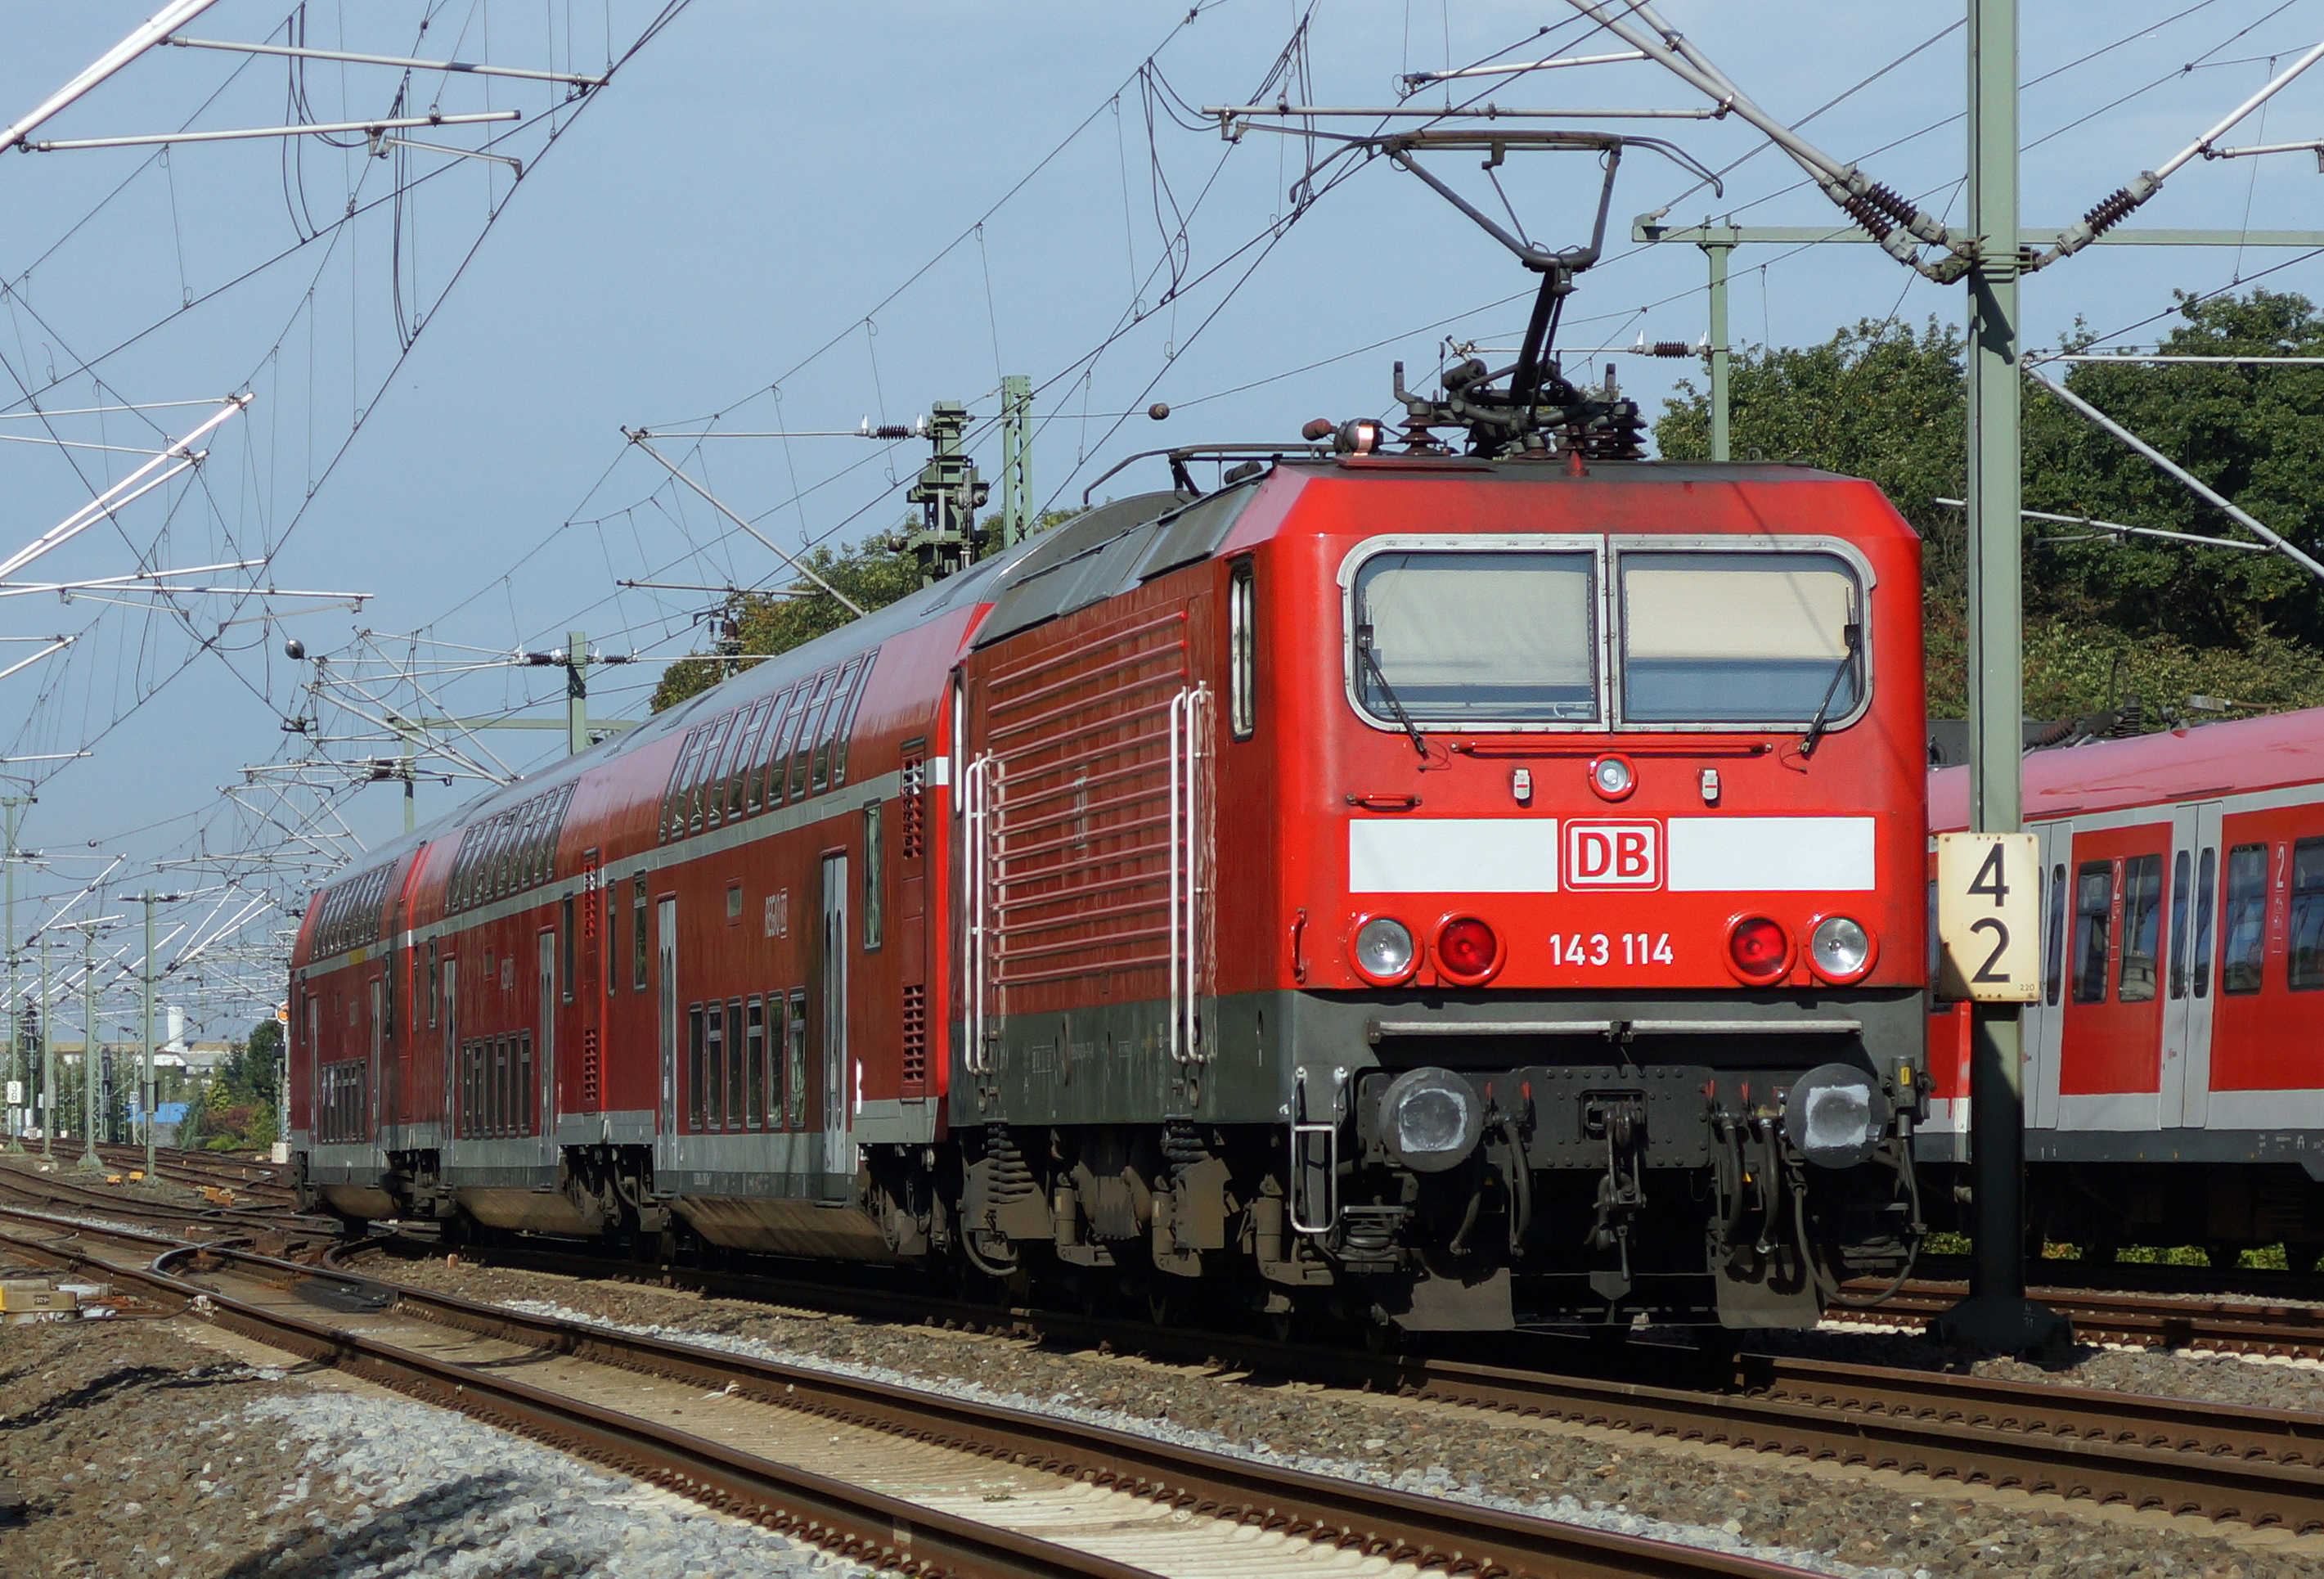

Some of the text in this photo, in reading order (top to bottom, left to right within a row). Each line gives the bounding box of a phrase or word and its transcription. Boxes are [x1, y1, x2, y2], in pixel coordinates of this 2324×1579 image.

[1579, 832, 1649, 877] DB
[1967, 843, 2010, 907] 4
[2276, 845, 2285, 888] 2
[1550, 933, 1674, 965] 143 114
[1970, 917, 2012, 983] 2
